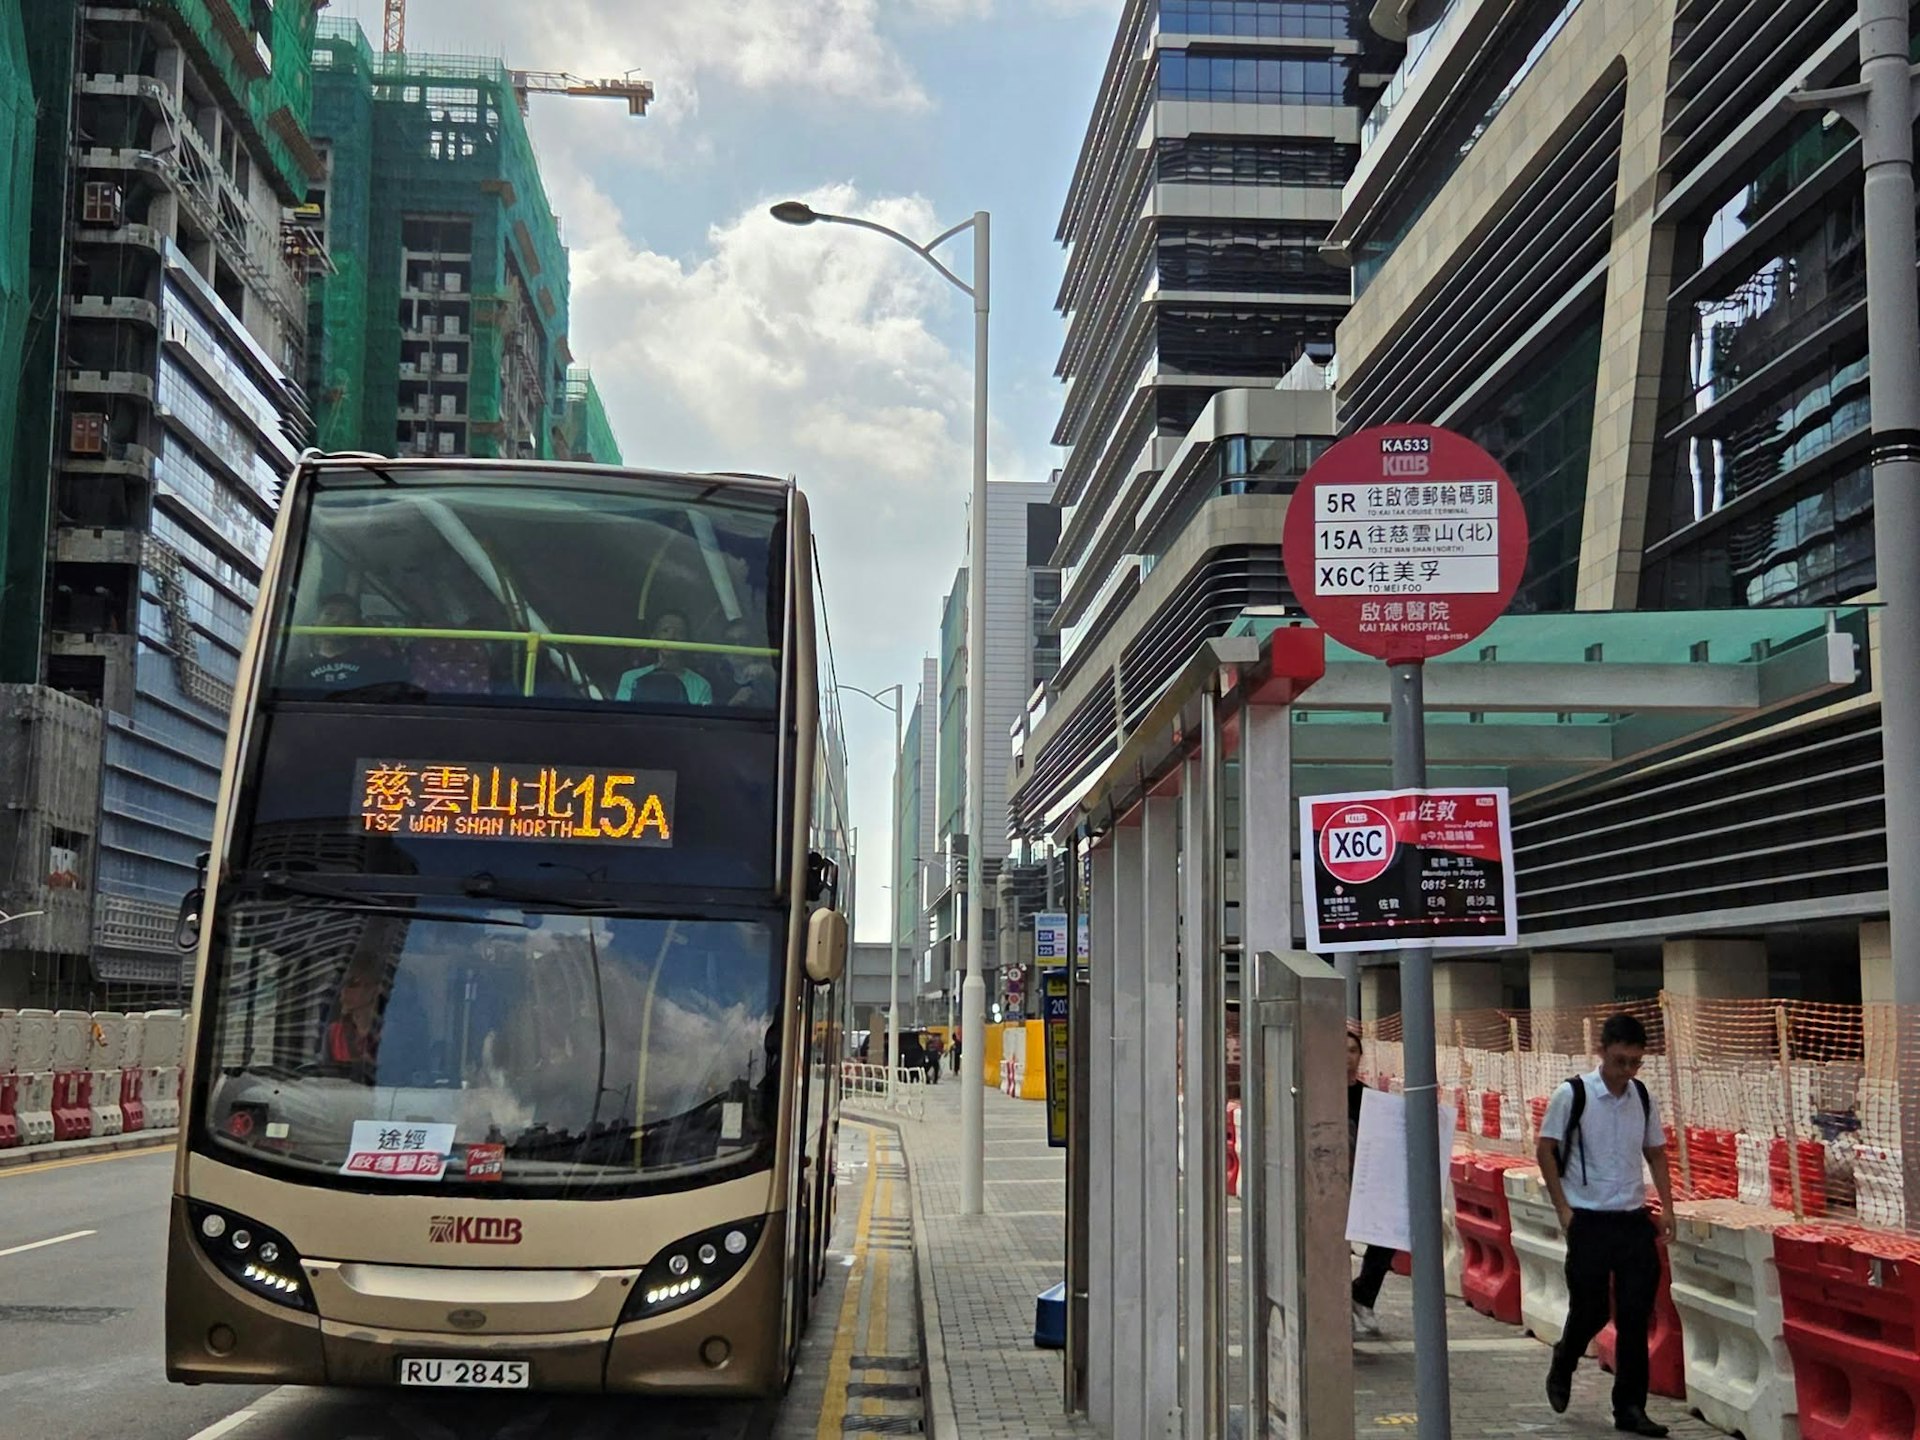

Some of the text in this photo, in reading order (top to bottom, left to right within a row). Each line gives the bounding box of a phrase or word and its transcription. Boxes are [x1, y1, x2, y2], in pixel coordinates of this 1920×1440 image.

[1382, 439, 1429, 452] KA533
[1382, 455, 1429, 476] KMB
[1327, 493, 1356, 513] 5R
[1320, 530, 1363, 550] 15A
[1367, 523, 1493, 543] 往慈雲山(北)
[1320, 567, 1365, 587] X6C
[1367, 561, 1441, 583] 往美孚
[1384, 584, 1400, 592] MEI
[1402, 584, 1422, 592] FOO
[1361, 602, 1450, 621] 啟德醫院
[1359, 622, 1451, 632] KAI TAK HOSPITAL
[362, 762, 574, 817] 慈雲山北
[573, 774, 670, 839] 15A
[1417, 800, 1458, 822] 佐敦
[362, 813, 573, 839] TSZ WAN SHAN NORTH
[1463, 819, 1493, 829] Jordan
[1334, 830, 1383, 859] X6C
[1457, 879, 1486, 890] 21:15
[378, 1128, 428, 1151] 途經
[350, 1154, 442, 1174] 啟德醫院
[455, 1216, 523, 1246] KMB
[407, 1362, 523, 1384] RU 2845
